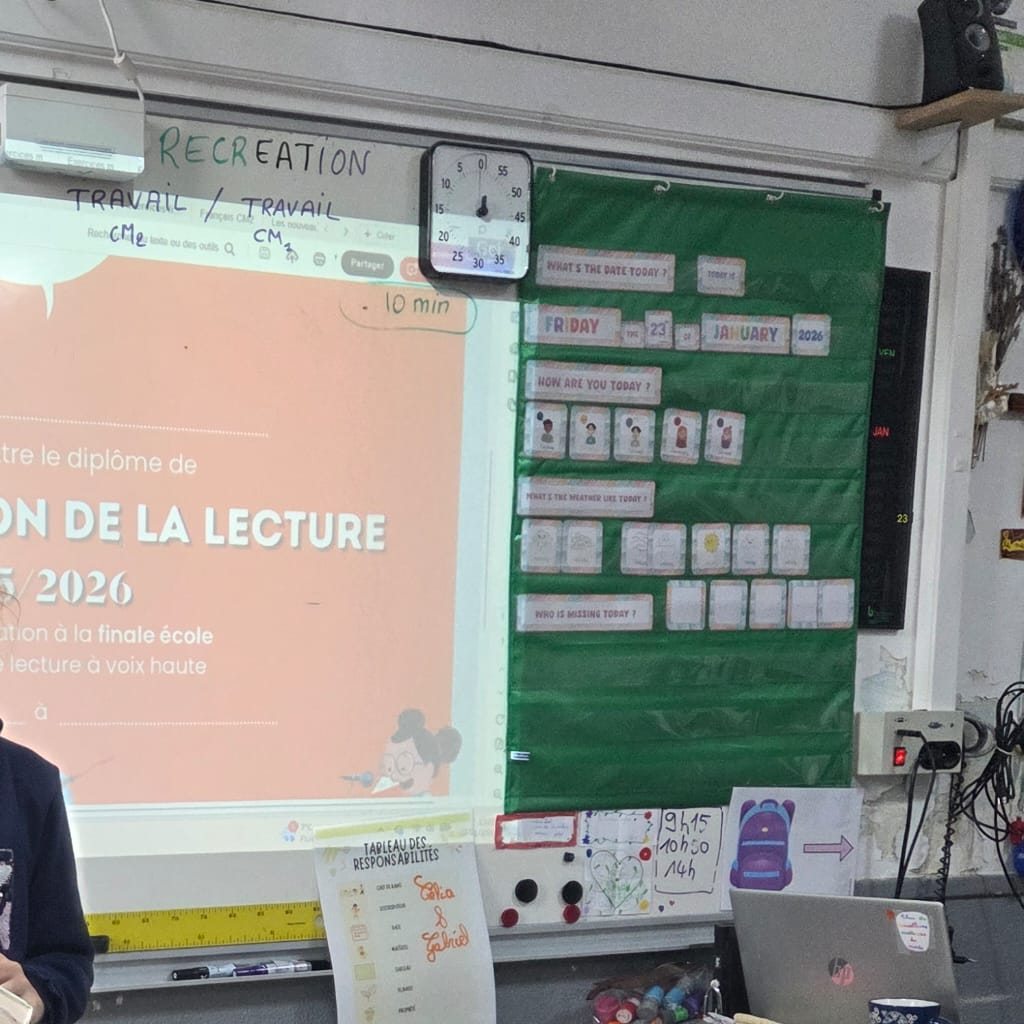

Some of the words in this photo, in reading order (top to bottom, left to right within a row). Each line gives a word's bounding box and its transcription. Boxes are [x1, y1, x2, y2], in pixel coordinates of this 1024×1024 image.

[159, 126, 372, 177] RECREATION
[456, 161, 464, 173] 5
[478, 158, 484, 170] 0
[497, 165, 509, 177] 55
[441, 178, 451, 189] 10
[511, 187, 522, 198] 50
[66, 181, 188, 214] TRAVAIL
[241, 192, 341, 221] TRAVAIL
[435, 203, 444, 215] 15
[514, 211, 526, 223] 45
[438, 230, 449, 242] 20
[508, 235, 521, 247] 40
[452, 250, 464, 262] 25
[472, 257, 484, 269] 30
[493, 253, 505, 265] 35
[584, 263, 602, 275] THE
[604, 265, 627, 276] DATE
[629, 266, 660, 278] TODAY
[412, 292, 450, 314] min
[544, 315, 601, 335] FRIDAY
[713, 324, 779, 343] JANUARY
[797, 330, 824, 342] 2026
[537, 375, 561, 389] HOW
[563, 377, 584, 390] ARE
[586, 378, 607, 391] YOU
[611, 379, 642, 393] TODAY
[872, 426, 890, 438] JAN
[41, 444, 62, 467] le
[67, 447, 163, 477] diplôme
[169, 450, 198, 475] de
[64, 500, 122, 542] DE
[136, 504, 191, 545] LA
[204, 506, 387, 552] LECTURE
[896, 513, 909, 524] 23
[535, 609, 555, 619] WHO
[567, 609, 601, 620] MISSING
[603, 609, 630, 619] TODAY
[53, 623, 68, 643] à
[74, 623, 93, 643] la
[97, 624, 156, 645] finale
[159, 625, 214, 645] école
[9, 655, 82, 674] lecture
[86, 655, 101, 674] à
[105, 656, 145, 675] voix
[149, 656, 208, 676] haute
[33, 704, 48, 721] à
[664, 810, 712, 835] 9h15
[363, 838, 408, 857] TABLEAU
[408, 836, 427, 850] DES
[353, 845, 440, 872] RESPONSABILITÉS
[664, 858, 696, 881] 14h
[421, 923, 470, 963] Gabriel
